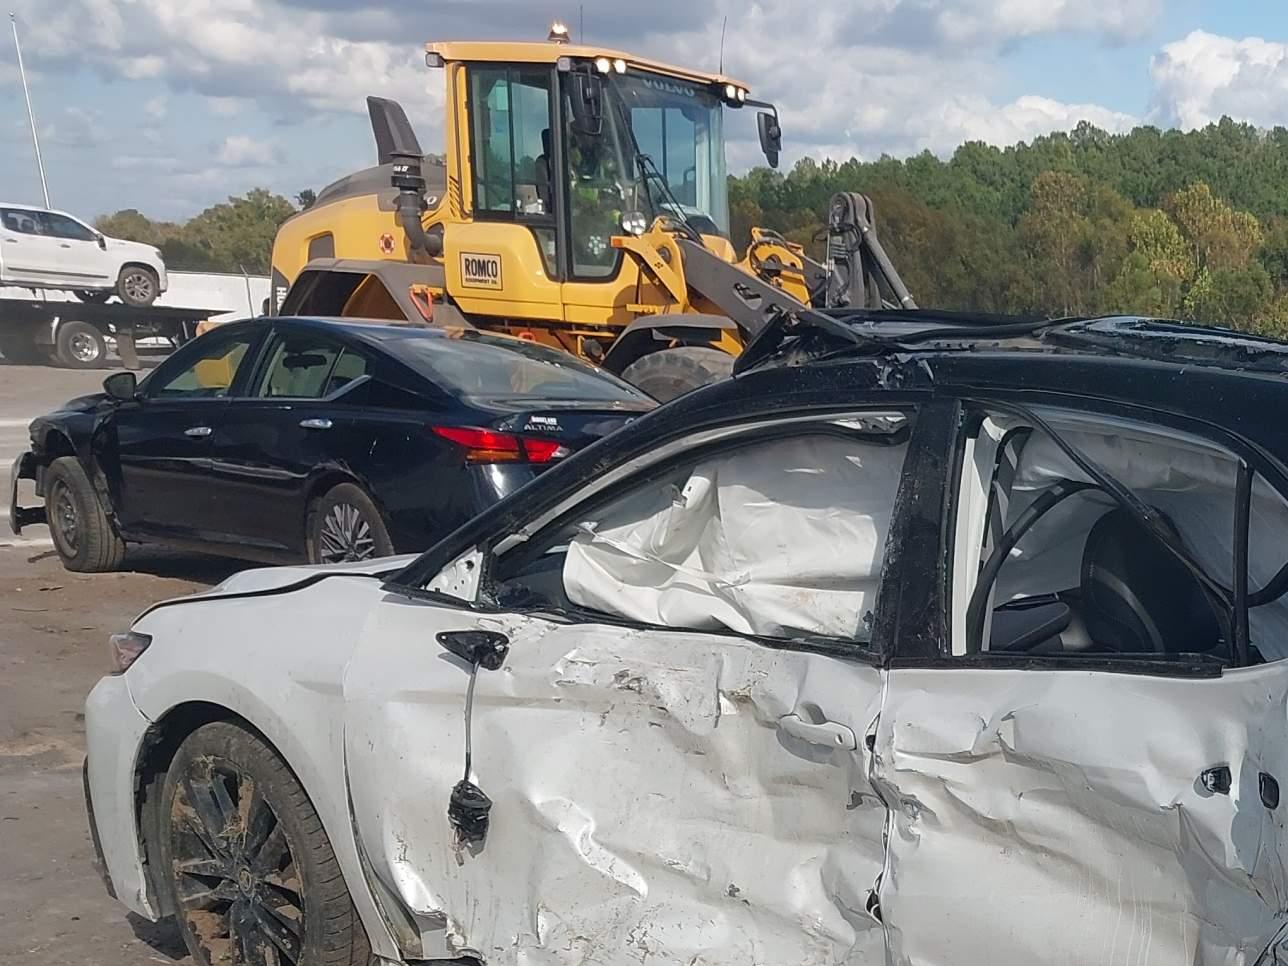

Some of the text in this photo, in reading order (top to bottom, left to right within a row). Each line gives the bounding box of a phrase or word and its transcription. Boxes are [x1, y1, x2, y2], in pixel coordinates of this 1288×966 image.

[643, 79, 695, 97] VOLVO
[464, 257, 498, 279] ROMCO
[523, 424, 564, 432] ALTIMA
